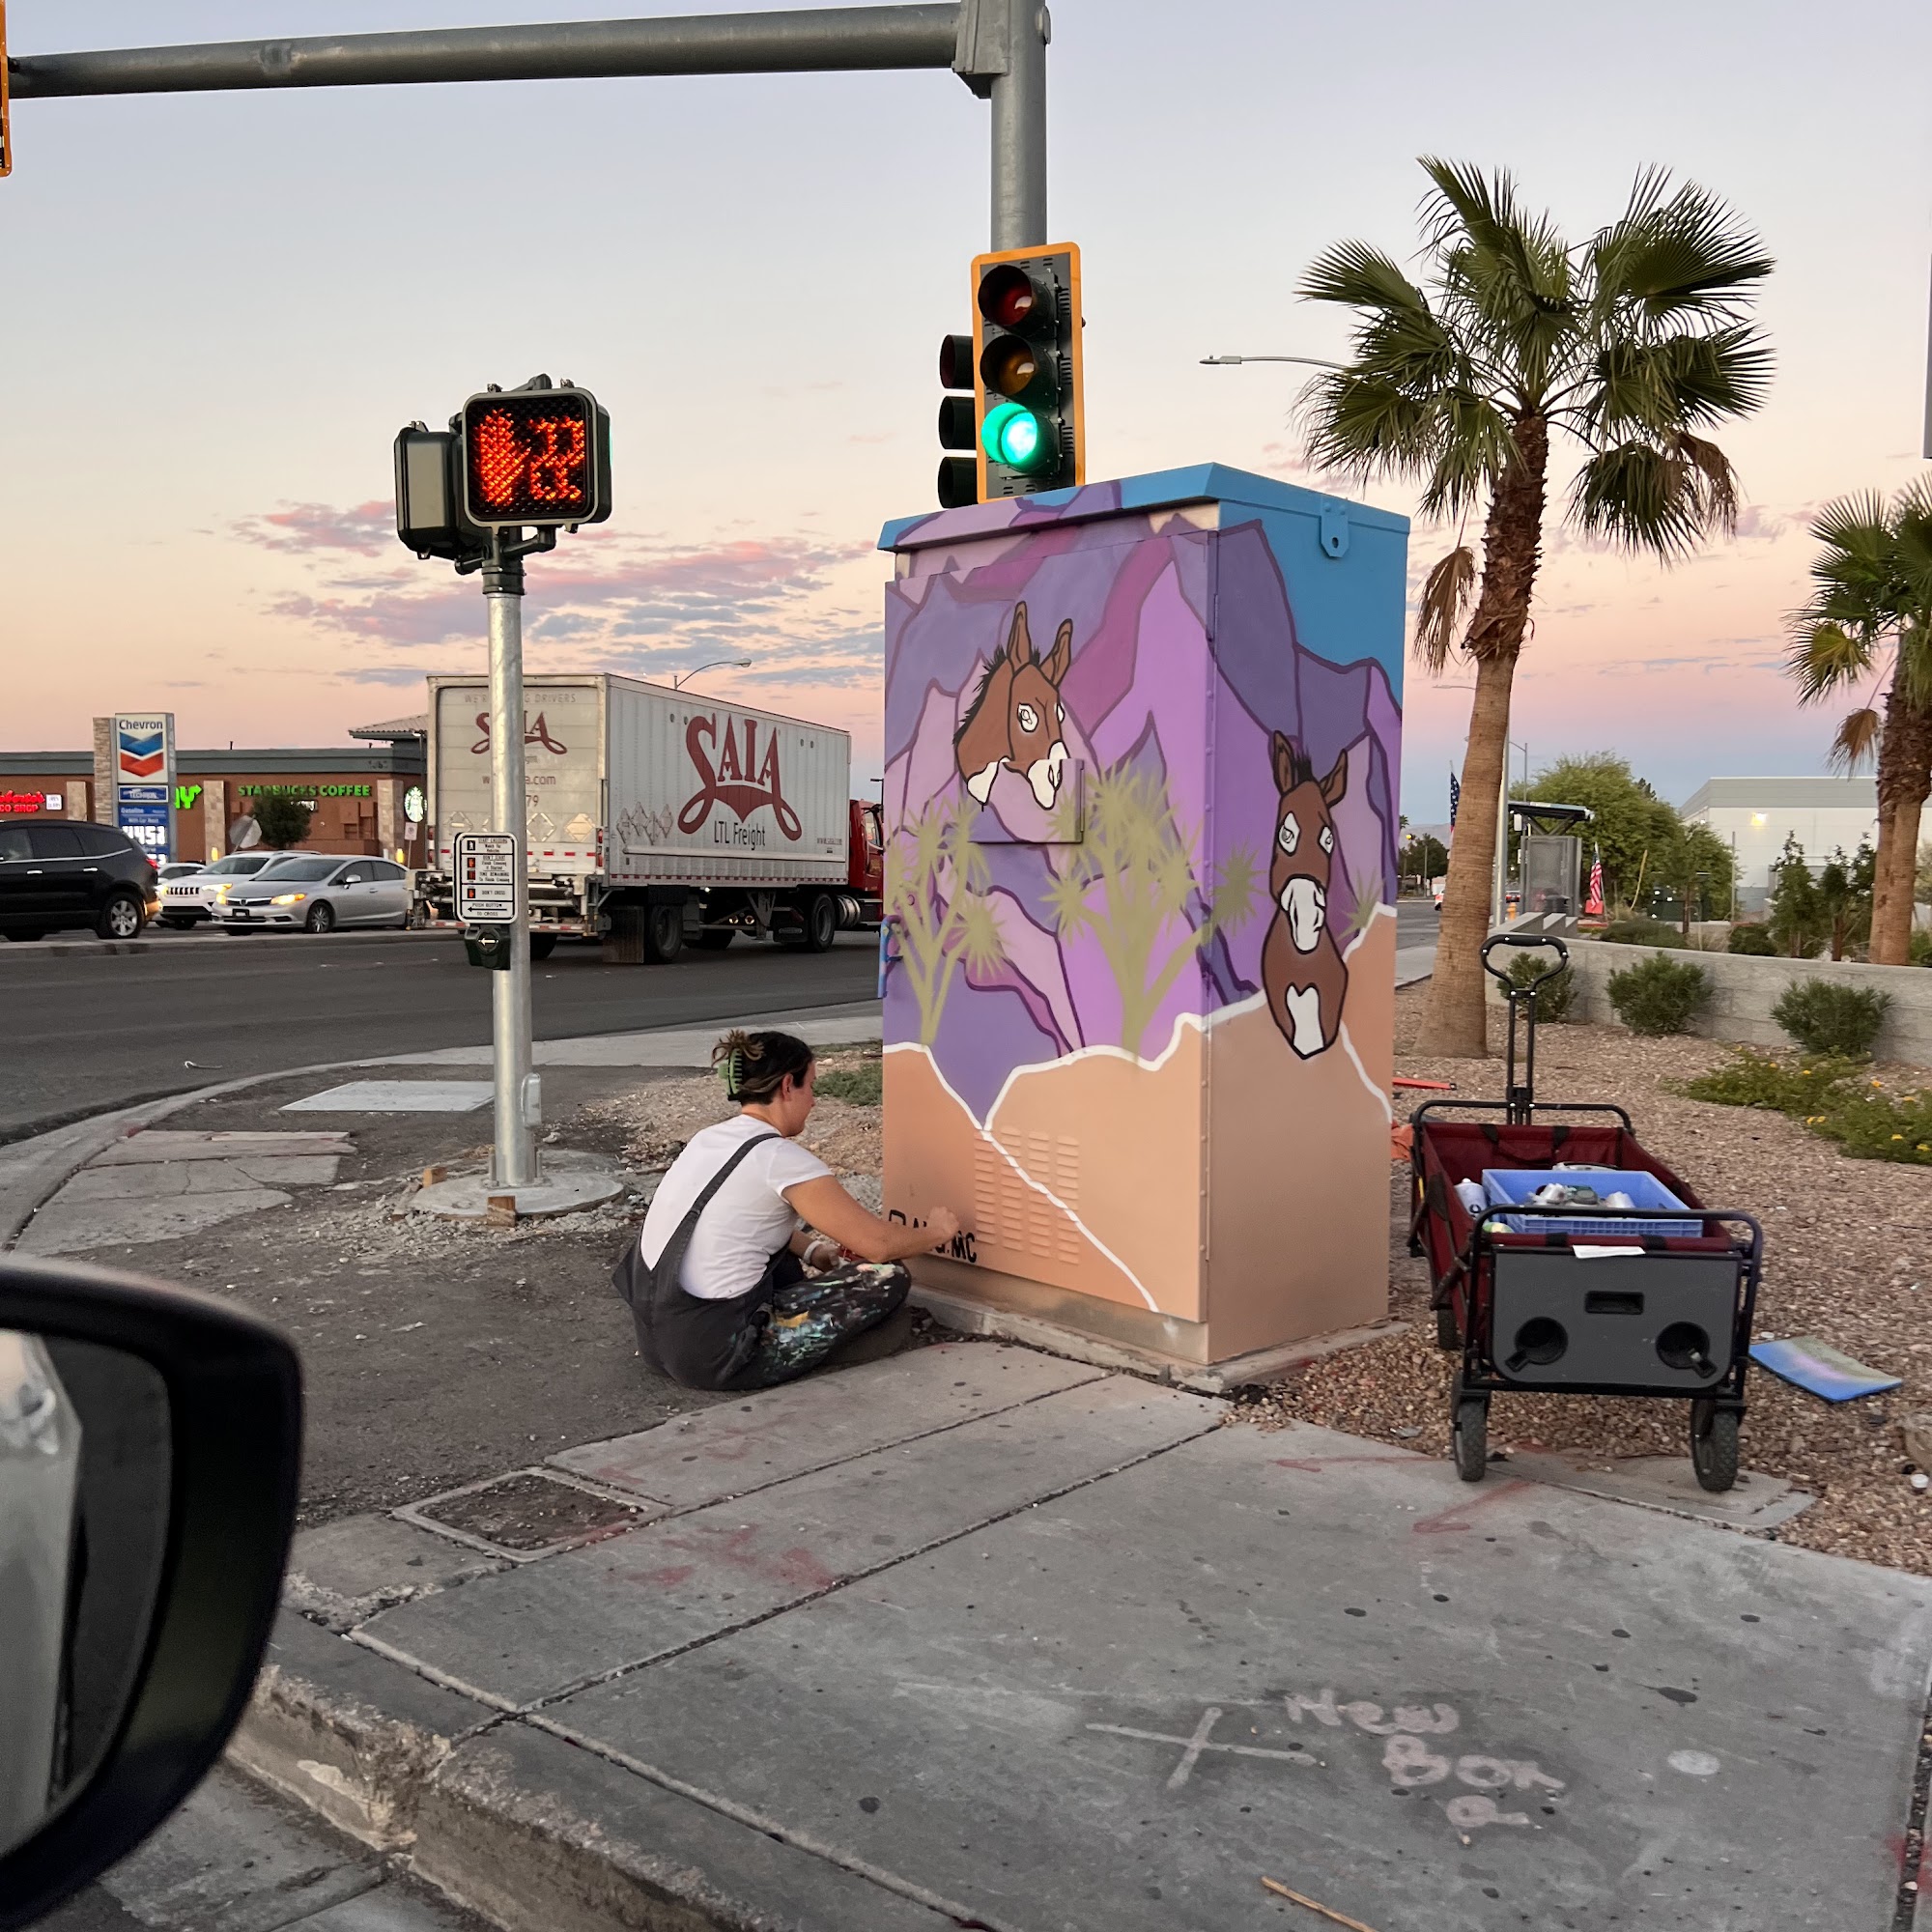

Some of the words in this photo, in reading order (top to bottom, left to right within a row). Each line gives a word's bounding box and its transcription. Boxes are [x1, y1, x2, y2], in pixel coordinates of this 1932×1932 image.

[119, 719, 163, 730] Chevron
[677, 712, 802, 840] SAIA
[319, 784, 372, 797] COFFEE
[714, 820, 730, 844] LTL
[732, 822, 767, 851] Freight
